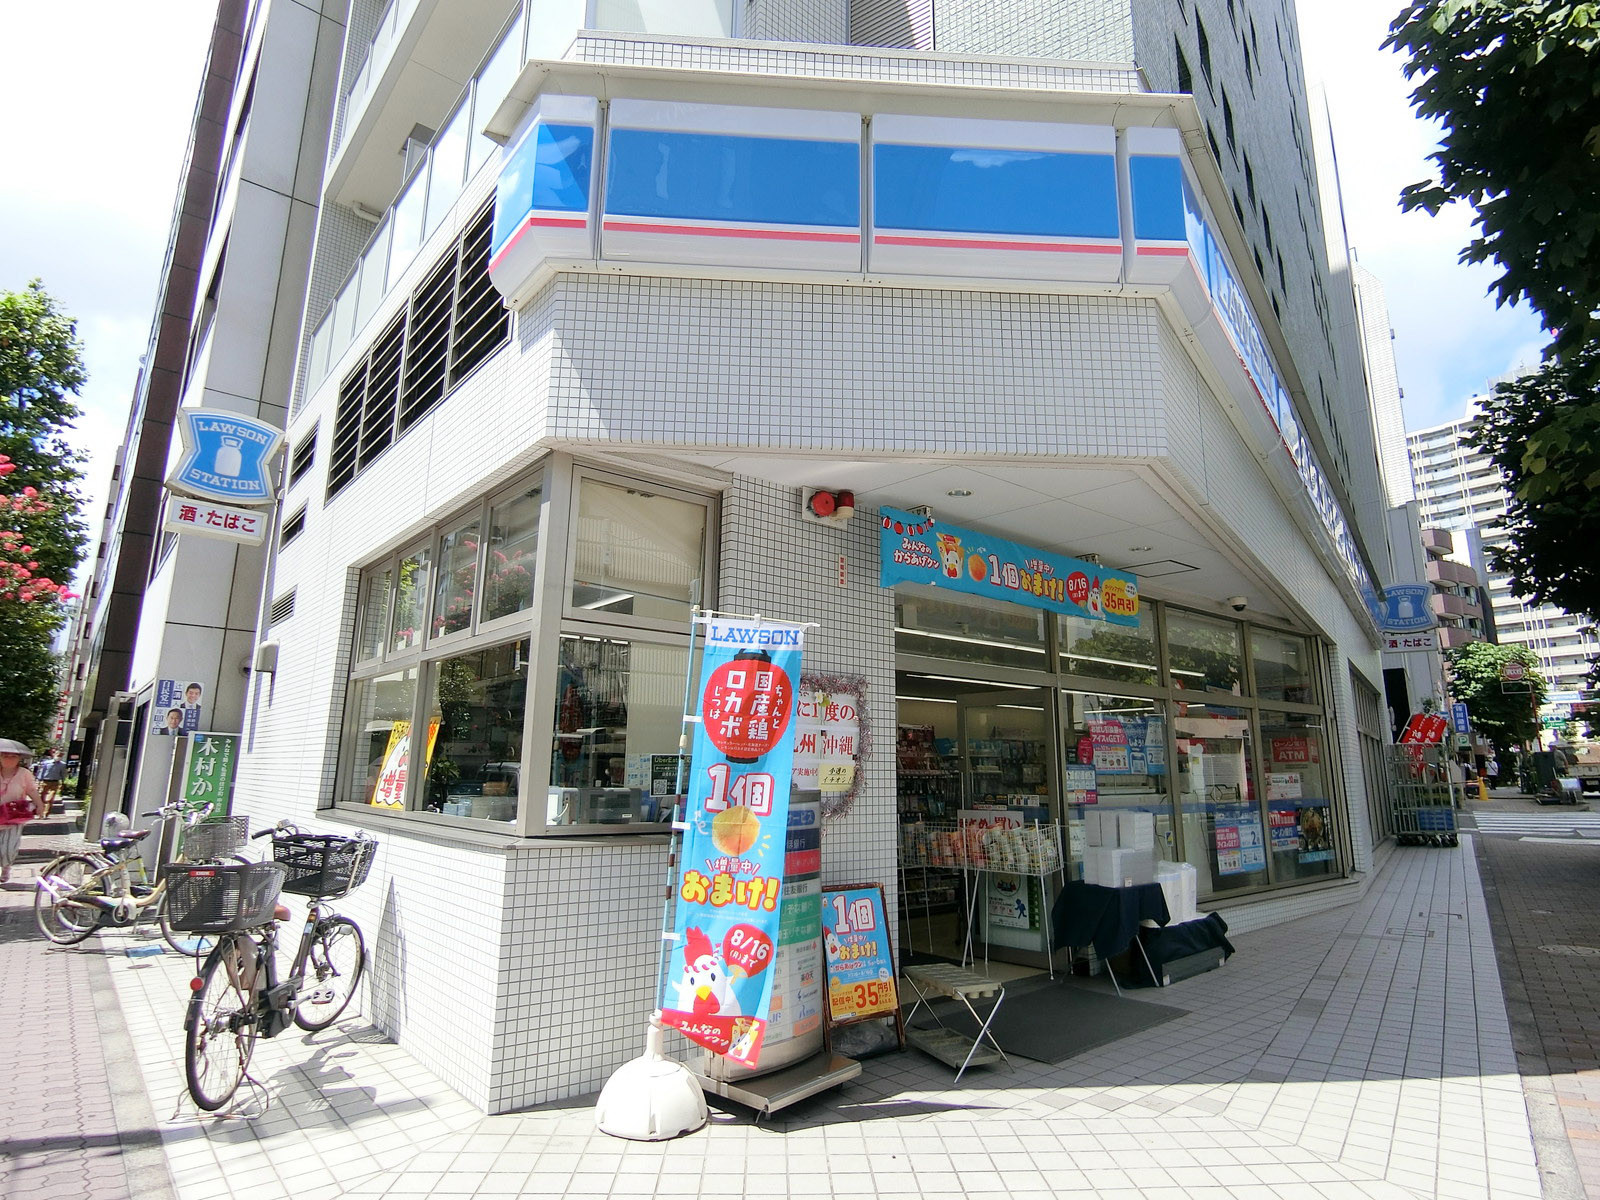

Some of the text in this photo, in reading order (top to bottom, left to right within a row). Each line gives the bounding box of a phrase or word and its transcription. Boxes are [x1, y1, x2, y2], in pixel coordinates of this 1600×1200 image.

[197, 421, 269, 445] LAWSON
[190, 468, 261, 491] STATION
[179, 505, 256, 533] 酒・たばこ
[901, 537, 932, 554] みんなの
[893, 549, 940, 569] からあげクン
[988, 553, 1020, 590] 1個
[1068, 577, 1087, 591] 8/16
[1385, 588, 1424, 596] LAWSON
[1104, 591, 1135, 612] 35円引
[1387, 616, 1428, 626] STATION
[710, 626, 799, 645] LAWSON
[1389, 638, 1432, 648] 酒・たばこ
[709, 685, 724, 719] じつは
[719, 670, 747, 738] ロカボ
[747, 671, 773, 740] 国産鶏
[772, 684, 784, 729] ちゃんと
[822, 734, 854, 755] 沖縄
[1279, 751, 1305, 760] ATM
[704, 763, 775, 816] 1個
[1250, 831, 1257, 845] 2
[714, 856, 752, 873] 増量中
[680, 869, 781, 912] おまけ!
[832, 894, 876, 934] 1個
[730, 929, 770, 960] 8/16
[839, 941, 877, 960] おまけ!
[730, 950, 758, 967] (月)まで
[679, 1021, 721, 1035] みんなの
